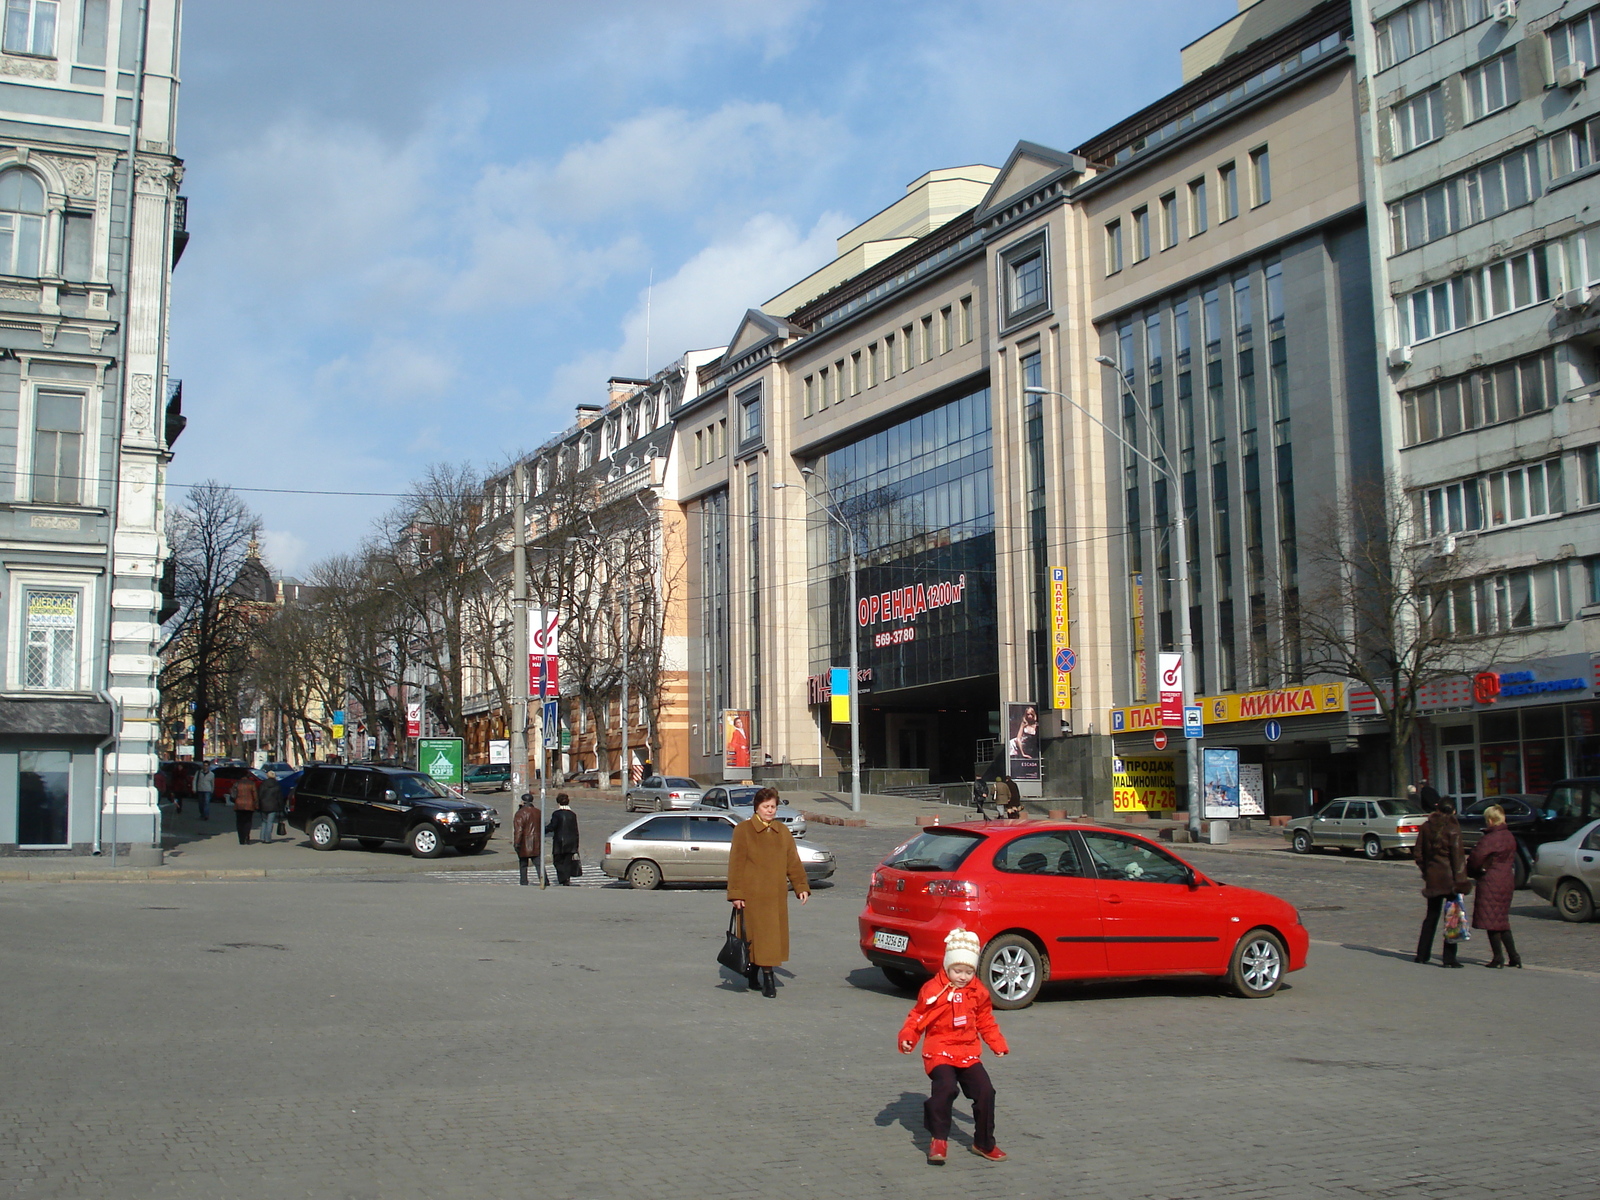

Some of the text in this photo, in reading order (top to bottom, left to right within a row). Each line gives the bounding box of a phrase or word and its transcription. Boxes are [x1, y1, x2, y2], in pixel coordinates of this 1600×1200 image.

[858, 583, 927, 627] ОРЕНДА
[1055, 583, 1064, 630] ПАРКІНГ
[875, 627, 915, 648] 569-3780
[1240, 689, 1316, 718] МИЙКА
[1126, 761, 1174, 773] ПРОДАЖ
[1114, 776, 1175, 789] МАШИНОМІСЦЬ
[1114, 791, 1175, 808] 561-47-26
[885, 935, 897, 946] 3256
